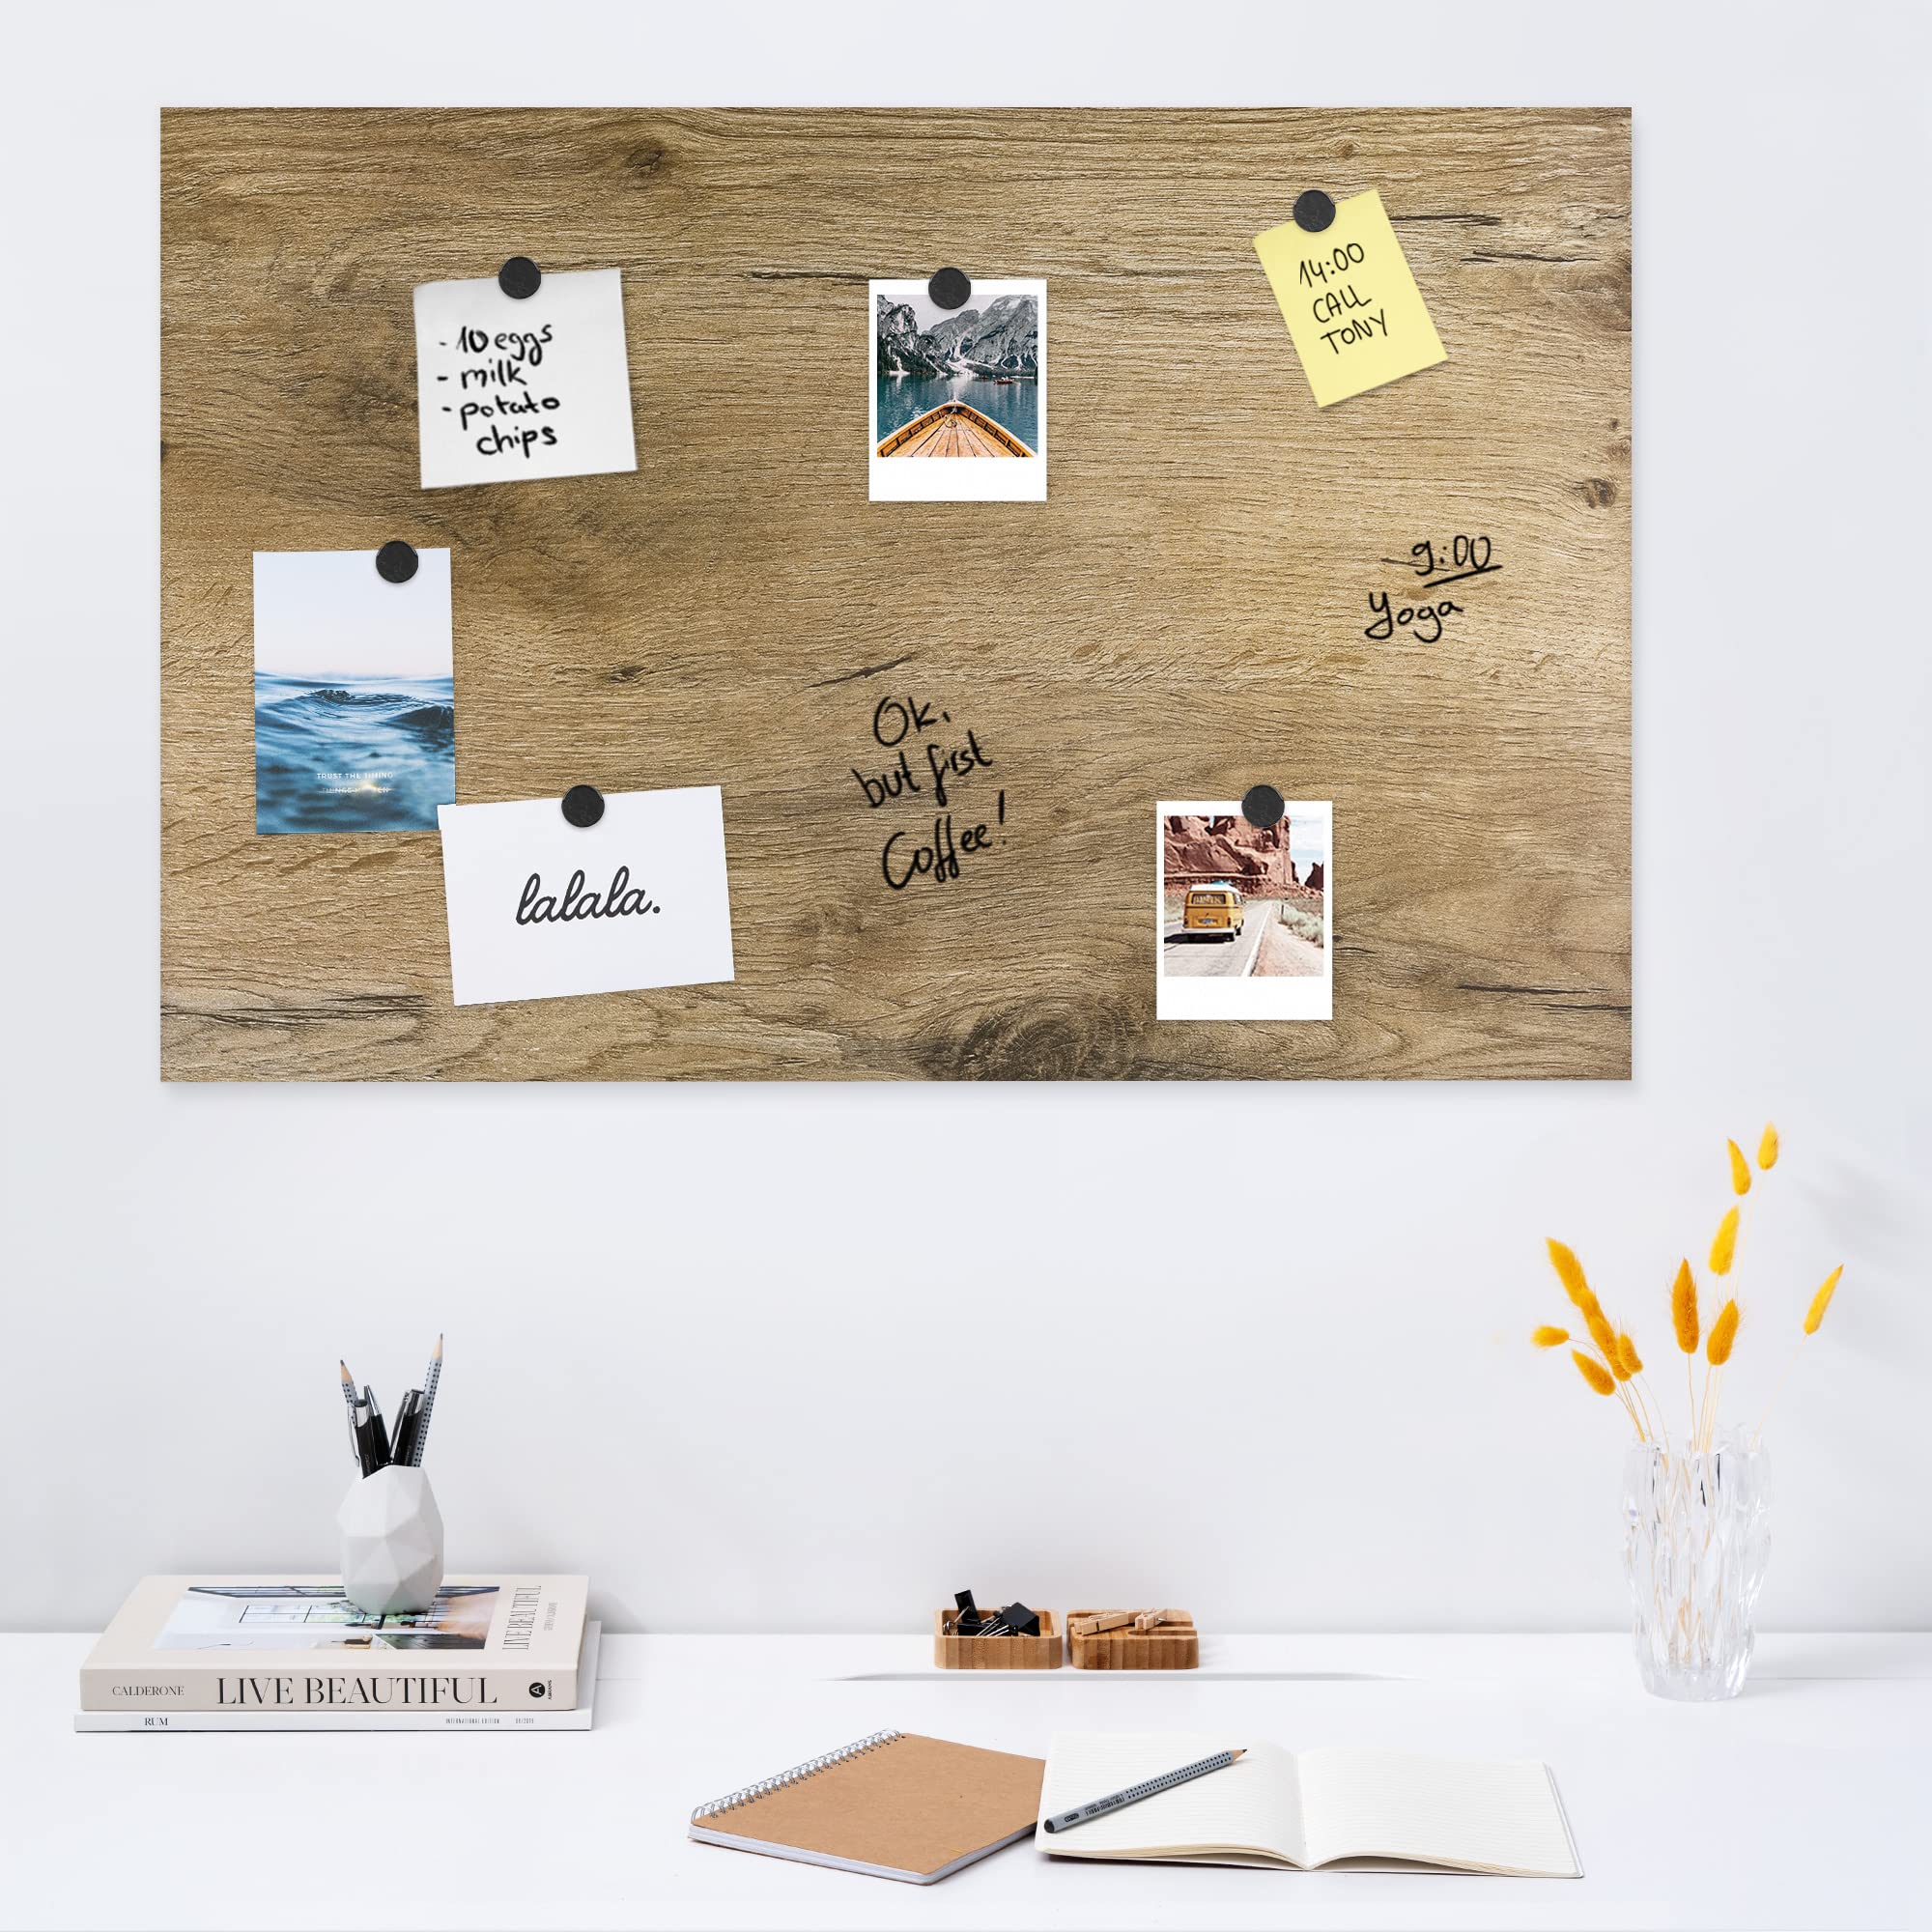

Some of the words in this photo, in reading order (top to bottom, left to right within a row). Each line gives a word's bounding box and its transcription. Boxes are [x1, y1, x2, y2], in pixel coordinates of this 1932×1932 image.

[1299, 242, 1365, 288] 14:00
[1313, 285, 1373, 324] CALL
[456, 326, 489, 354] 10
[494, 324, 554, 366] eggs
[1320, 308, 1388, 355] TONY
[461, 358, 527, 389] milk
[460, 390, 561, 431] potato
[476, 424, 558, 459] chips
[1411, 535, 1492, 577] 9:00
[851, 751, 921, 808] but
[927, 729, 993, 808] first
[516, 866, 661, 925] lalala.
[112, 1686, 185, 1696] CALDERONE
[216, 1677, 294, 1704] LIVE
[303, 1677, 497, 1704] BEAUTIFUL
[145, 1717, 168, 1726] RUM
